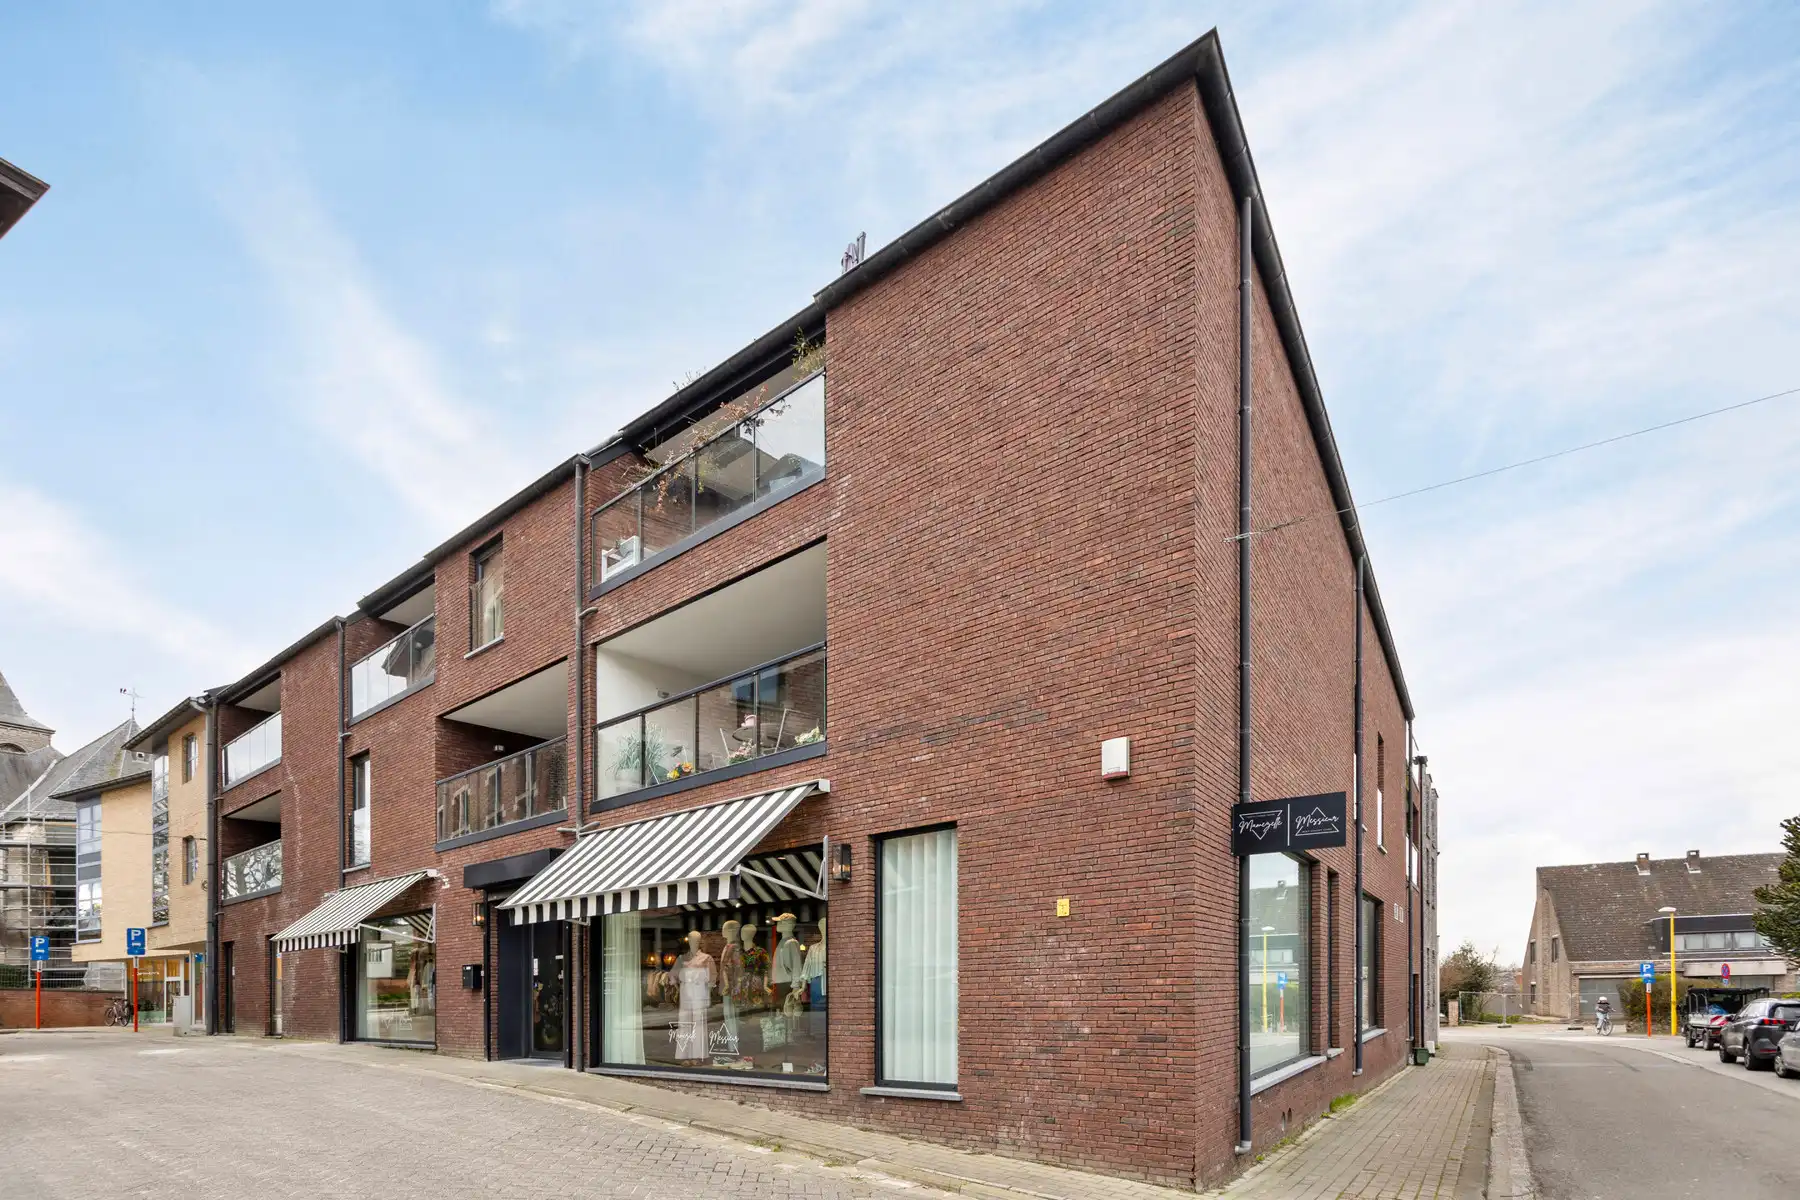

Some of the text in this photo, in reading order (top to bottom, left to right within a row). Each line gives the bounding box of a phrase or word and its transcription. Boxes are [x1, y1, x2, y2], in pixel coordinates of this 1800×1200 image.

[131, 929, 141, 941] P
[35, 937, 45, 948] P
[1643, 964, 1651, 973] P
